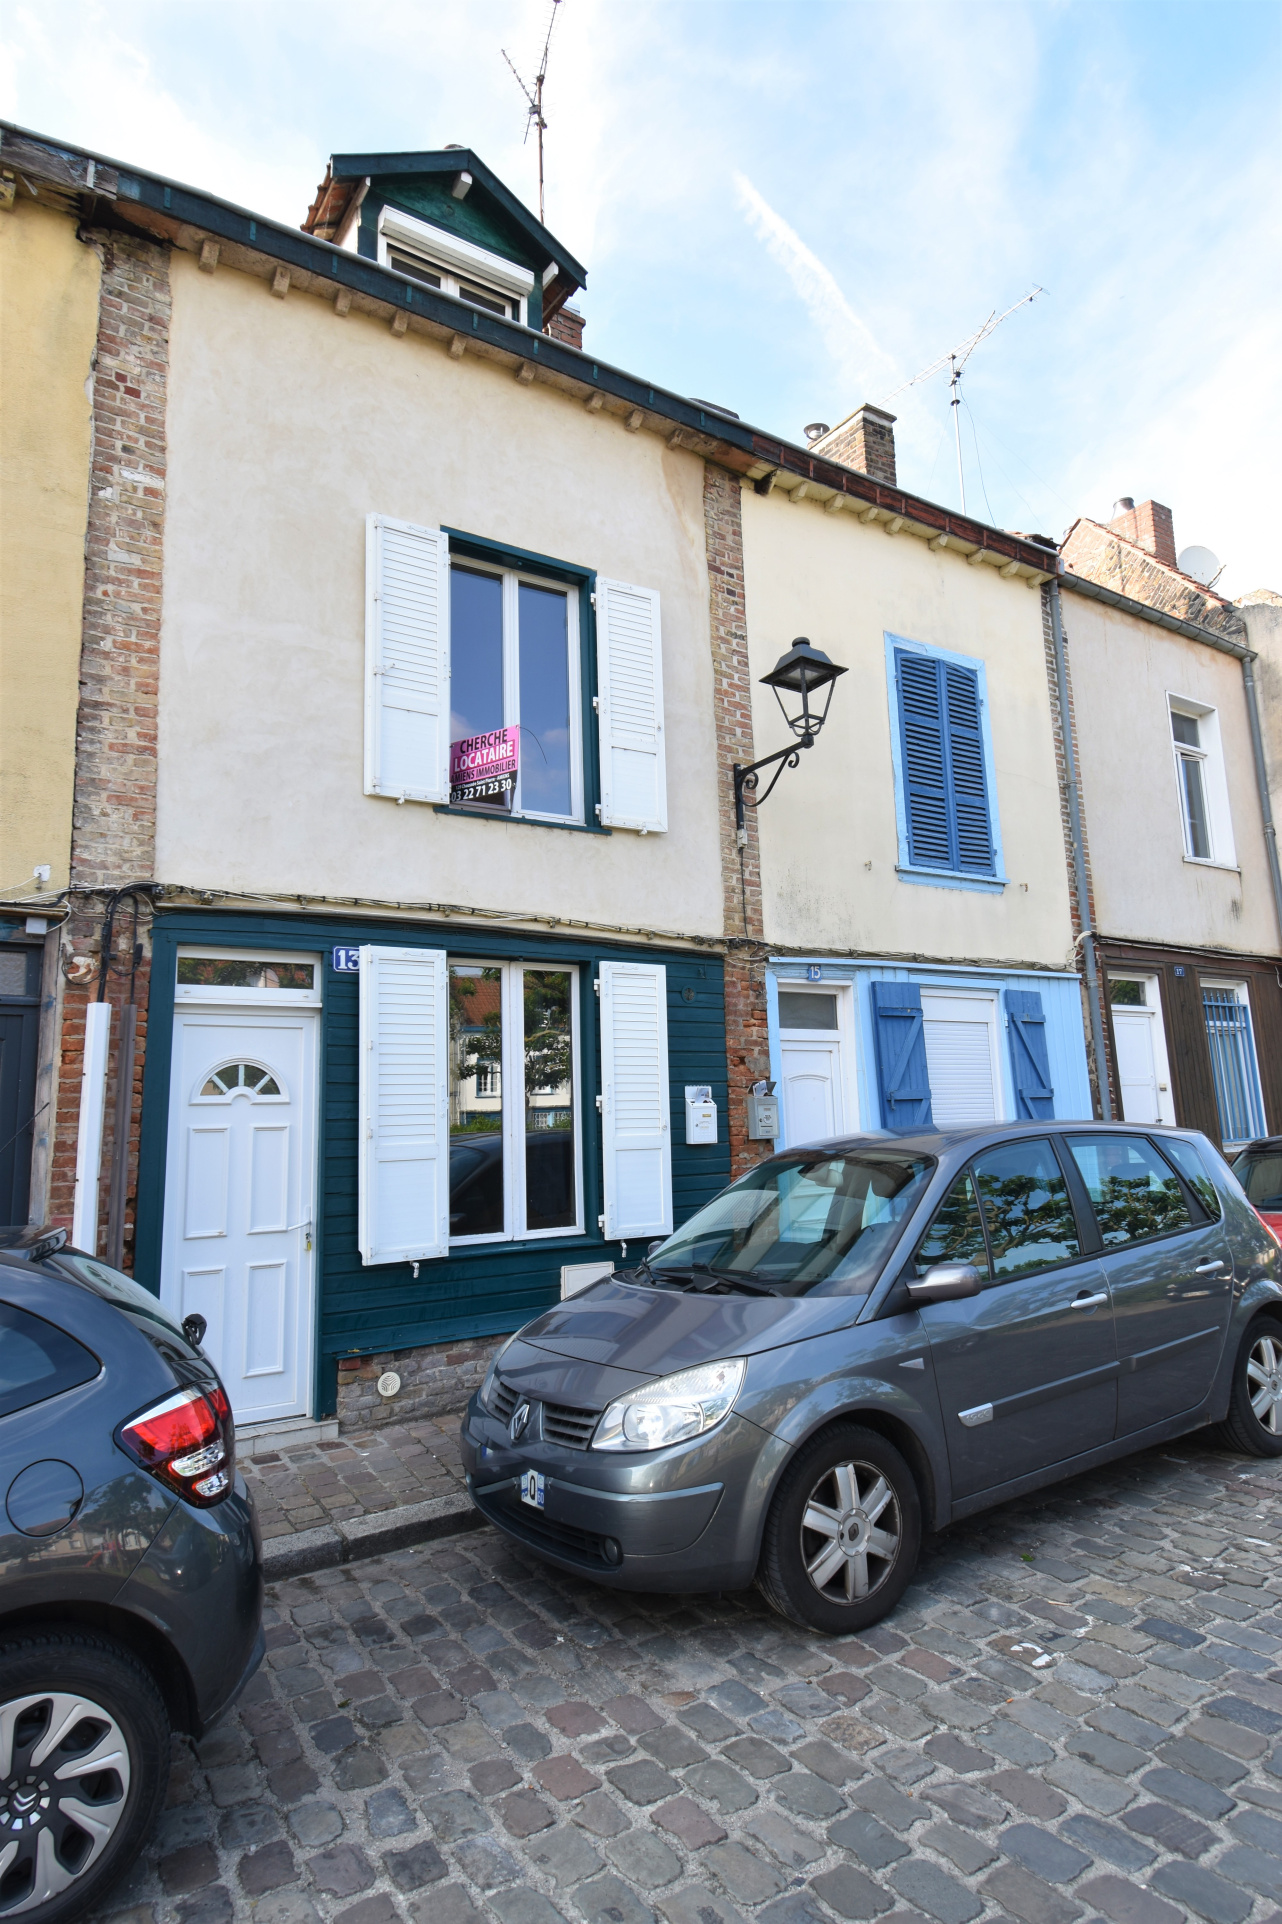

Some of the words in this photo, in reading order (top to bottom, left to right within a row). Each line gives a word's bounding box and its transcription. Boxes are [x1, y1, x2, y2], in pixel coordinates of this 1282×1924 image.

[460, 729, 508, 754] CHERCHE
[454, 741, 513, 772] LOCATAIRE
[450, 769, 475, 784] AMIENS
[476, 759, 516, 778] IMMOBILIER
[463, 788, 474, 800] 22
[475, 785, 486, 797] 71
[487, 782, 500, 794] 23
[500, 779, 512, 791] 30
[338, 950, 360, 970] 13
[810, 965, 821, 979] 15
